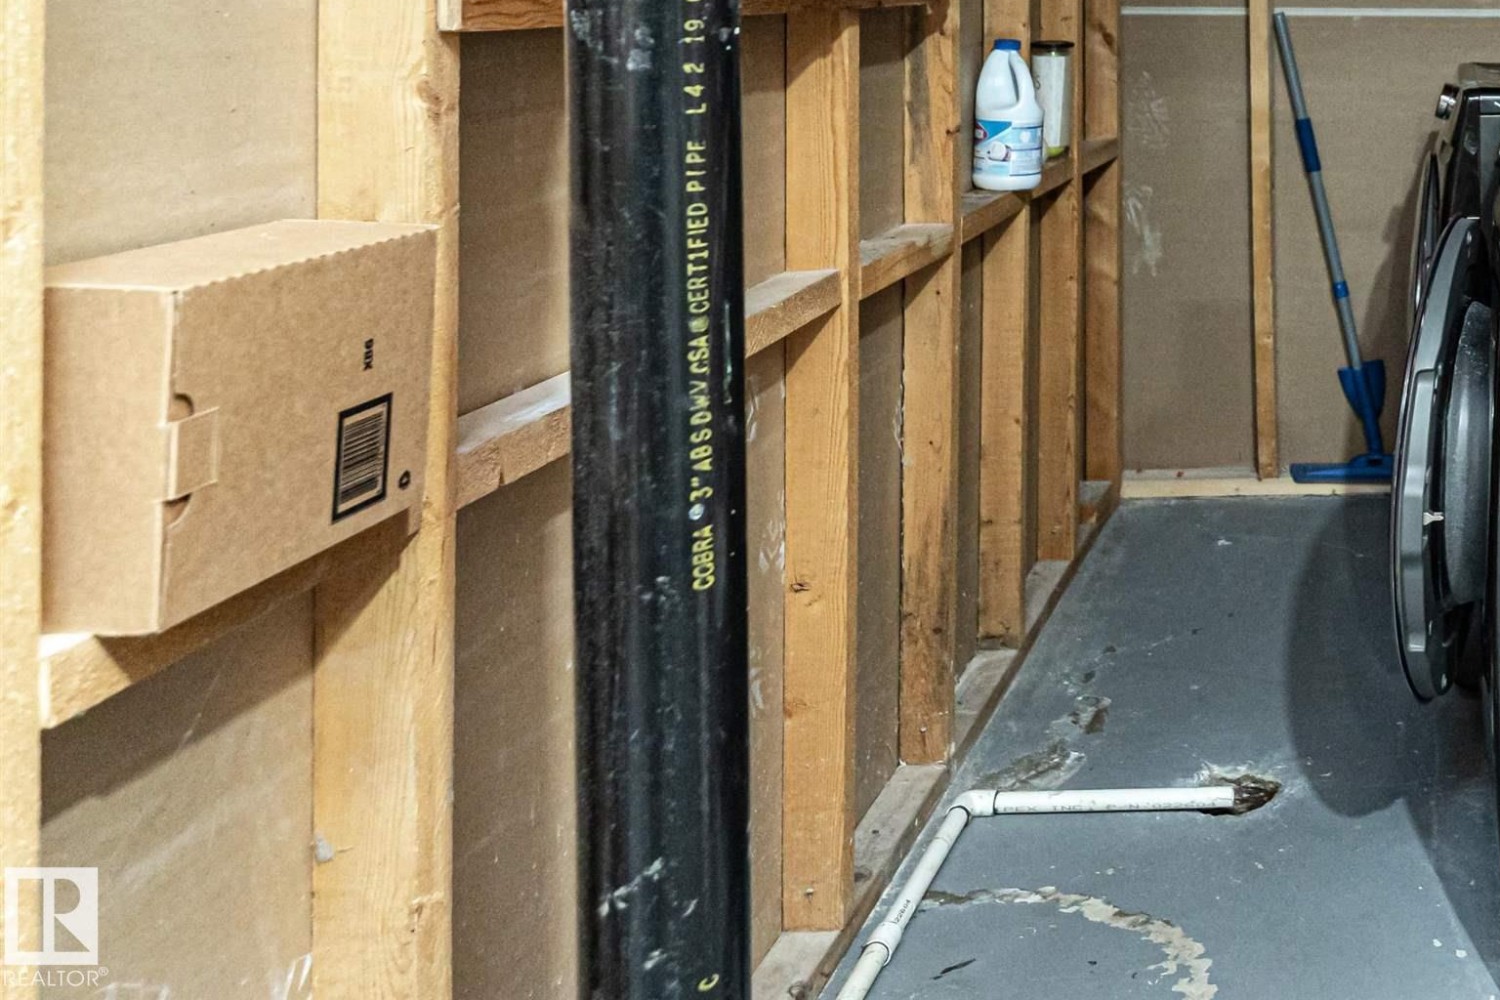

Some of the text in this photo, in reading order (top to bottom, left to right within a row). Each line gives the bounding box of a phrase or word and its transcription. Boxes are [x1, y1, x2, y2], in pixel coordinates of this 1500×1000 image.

[685, 140, 707, 193] PIPE
[687, 334, 711, 375] CSA
[691, 523, 716, 592] COBRA
